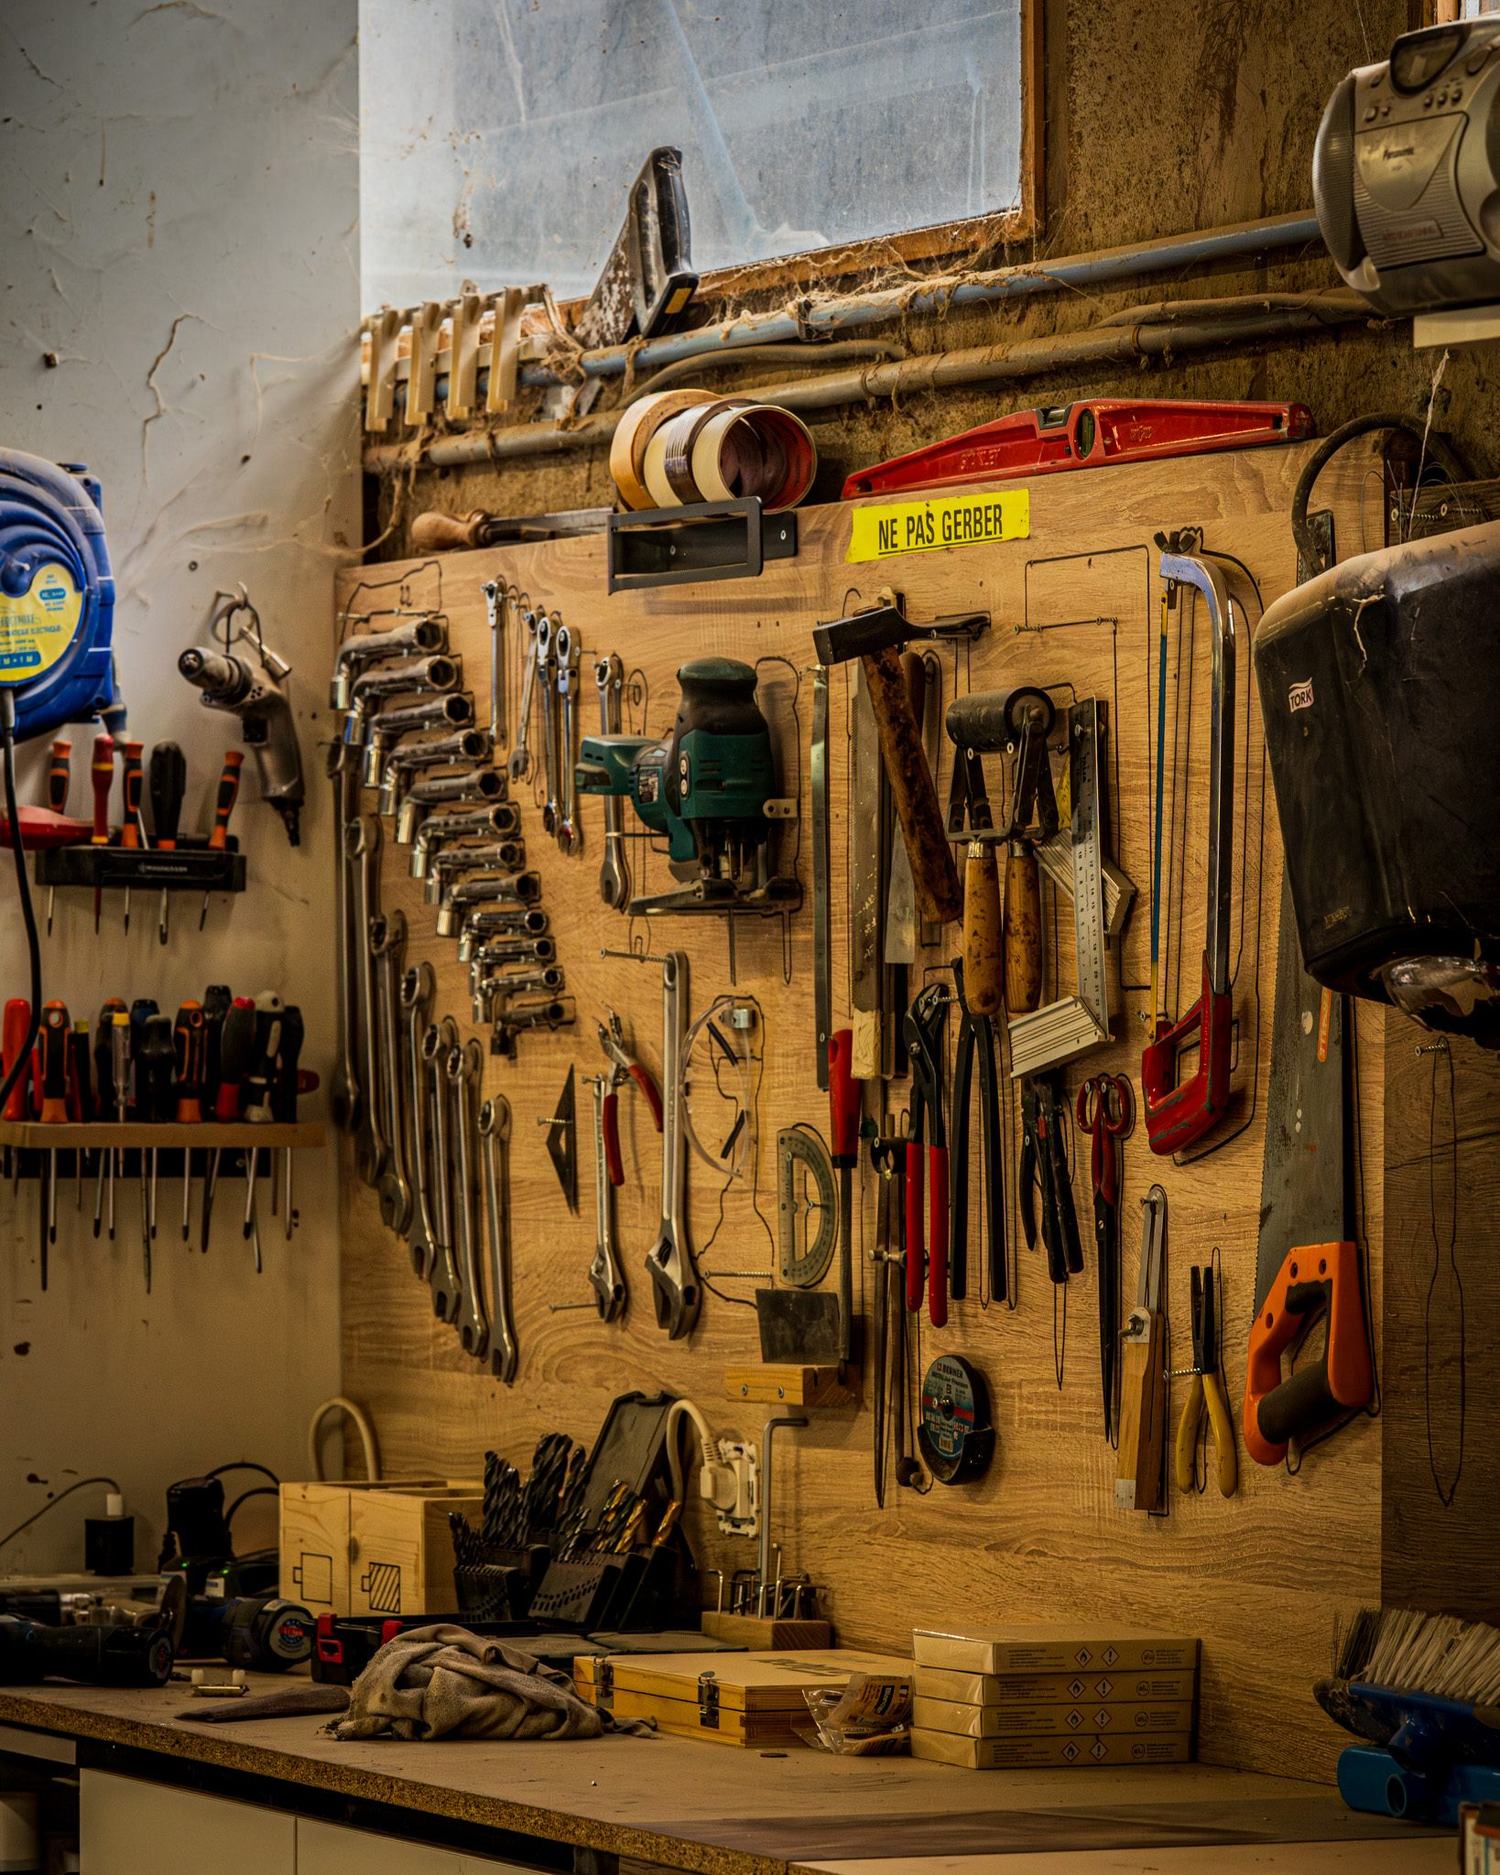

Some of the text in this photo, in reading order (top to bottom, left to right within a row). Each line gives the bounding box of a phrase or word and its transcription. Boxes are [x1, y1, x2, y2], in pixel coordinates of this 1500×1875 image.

[878, 503, 1003, 550] NE PAS GERBER
[1290, 687, 1312, 709] TORK
